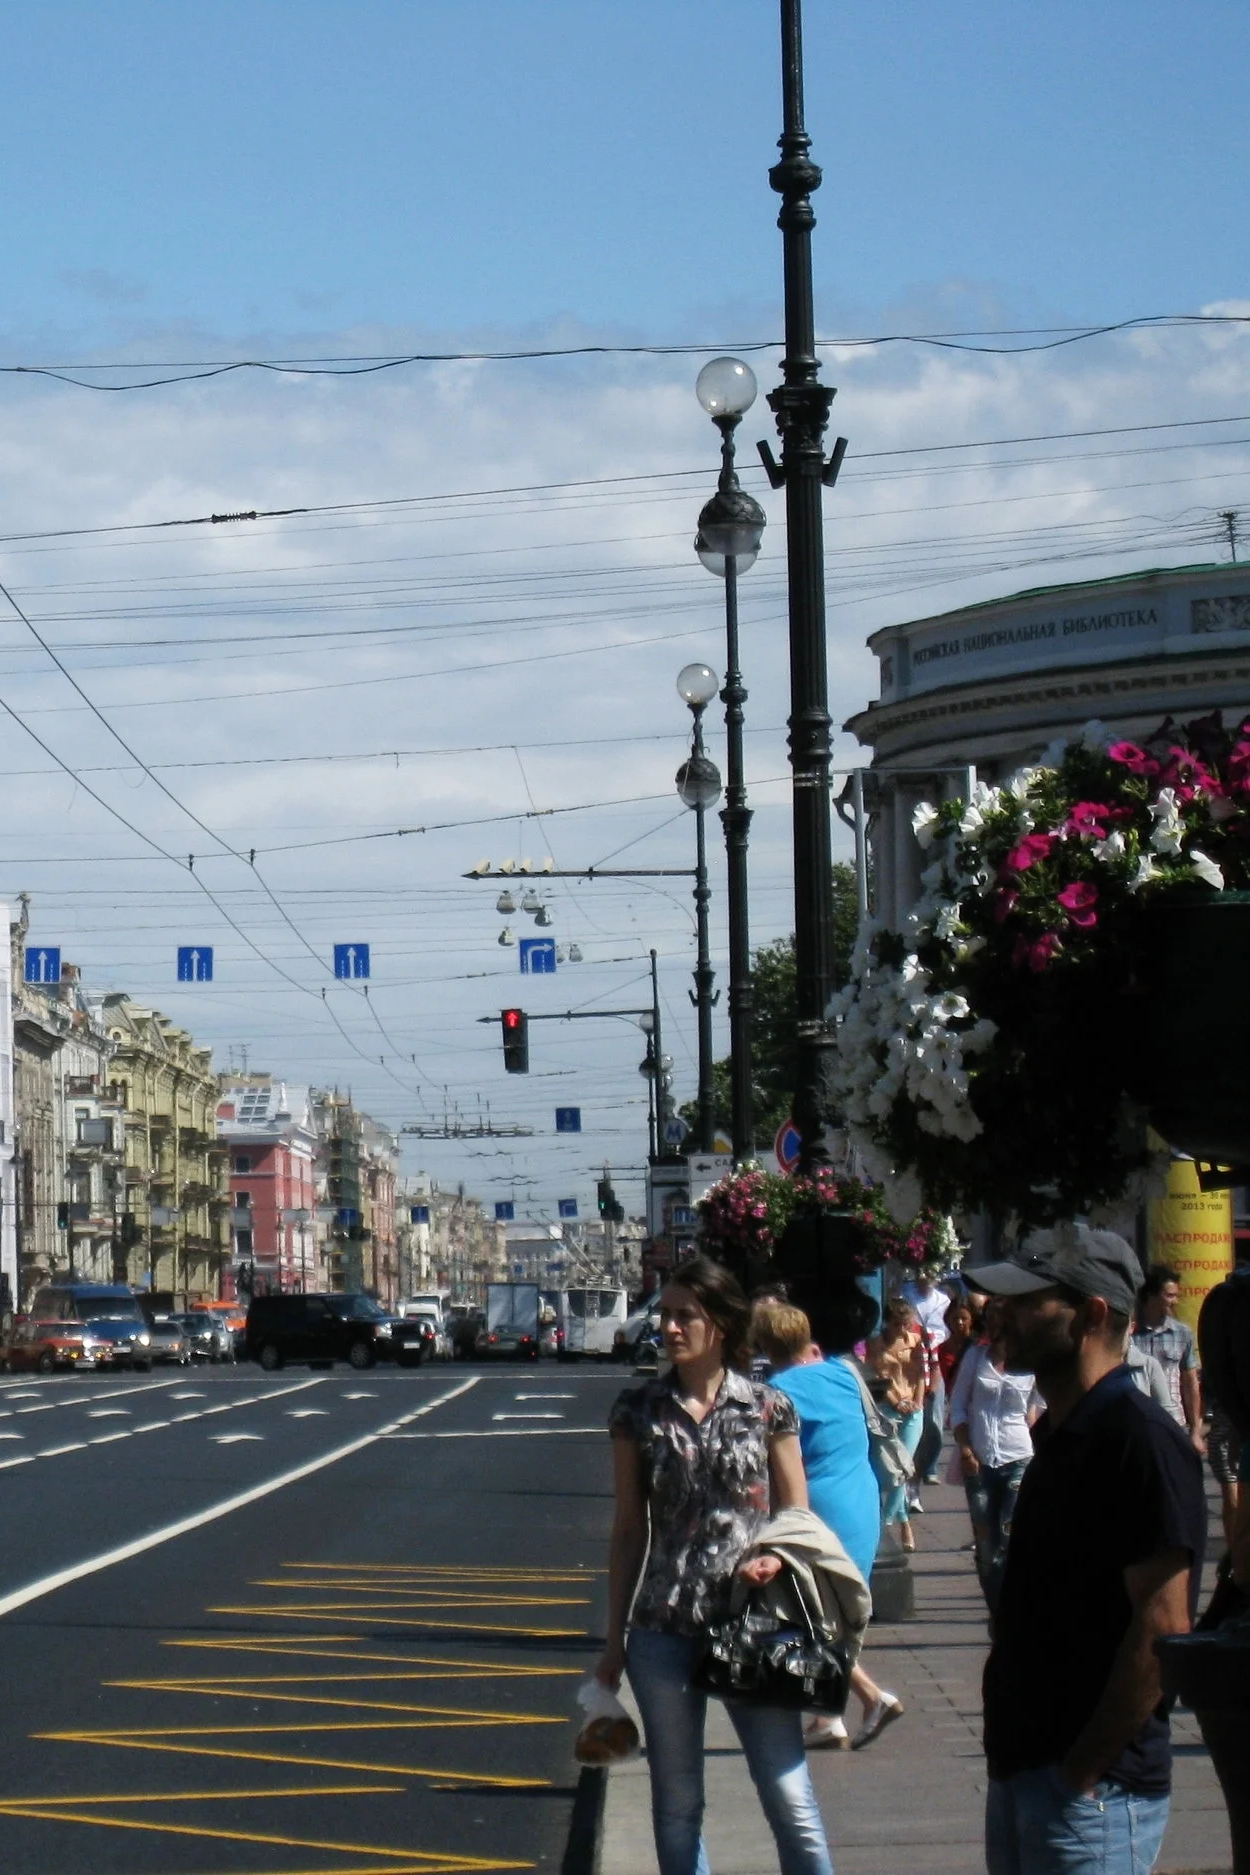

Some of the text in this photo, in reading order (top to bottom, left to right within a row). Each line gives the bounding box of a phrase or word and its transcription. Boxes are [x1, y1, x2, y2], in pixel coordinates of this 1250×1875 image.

[1062, 608, 1158, 635] БИБЛИОТЕКА
[1181, 1202, 1223, 1211] 2013 года
